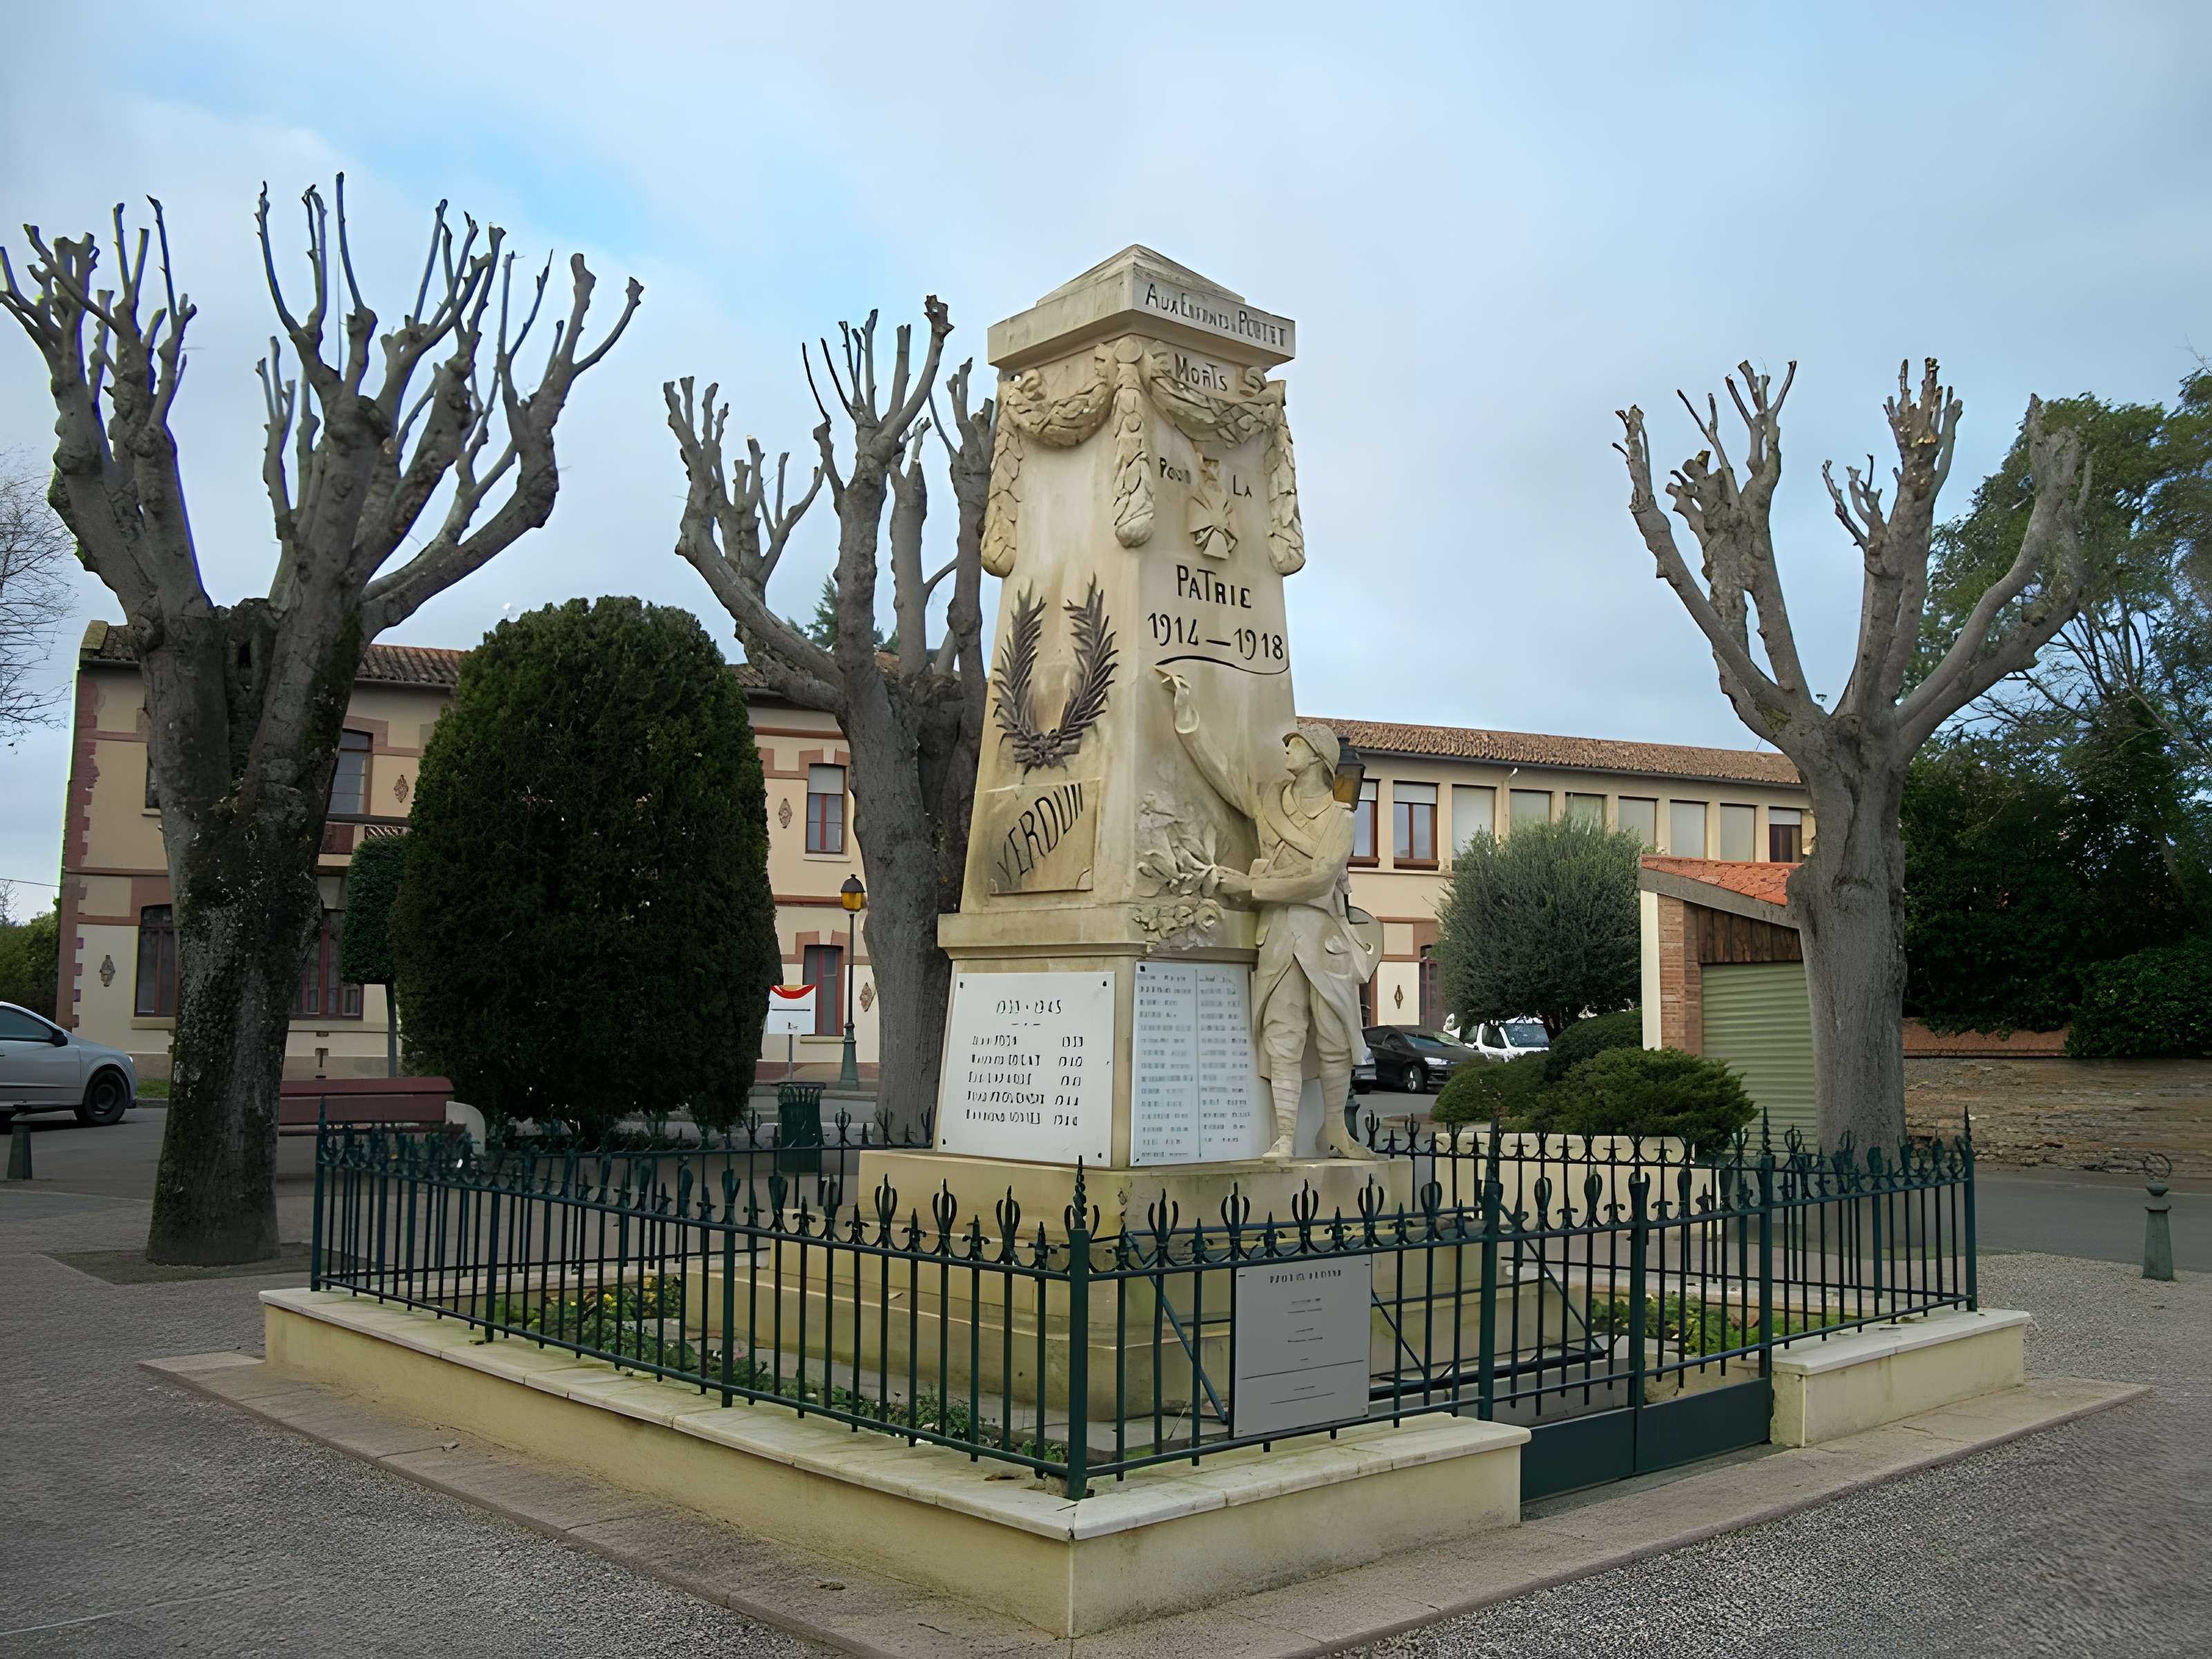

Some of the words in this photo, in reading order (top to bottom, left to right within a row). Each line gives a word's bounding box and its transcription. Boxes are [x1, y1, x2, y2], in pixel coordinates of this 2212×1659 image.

[1174, 353, 1228, 392] MORTS
[1233, 475, 1252, 498] LA
[1177, 564, 1252, 609] PATRIE
